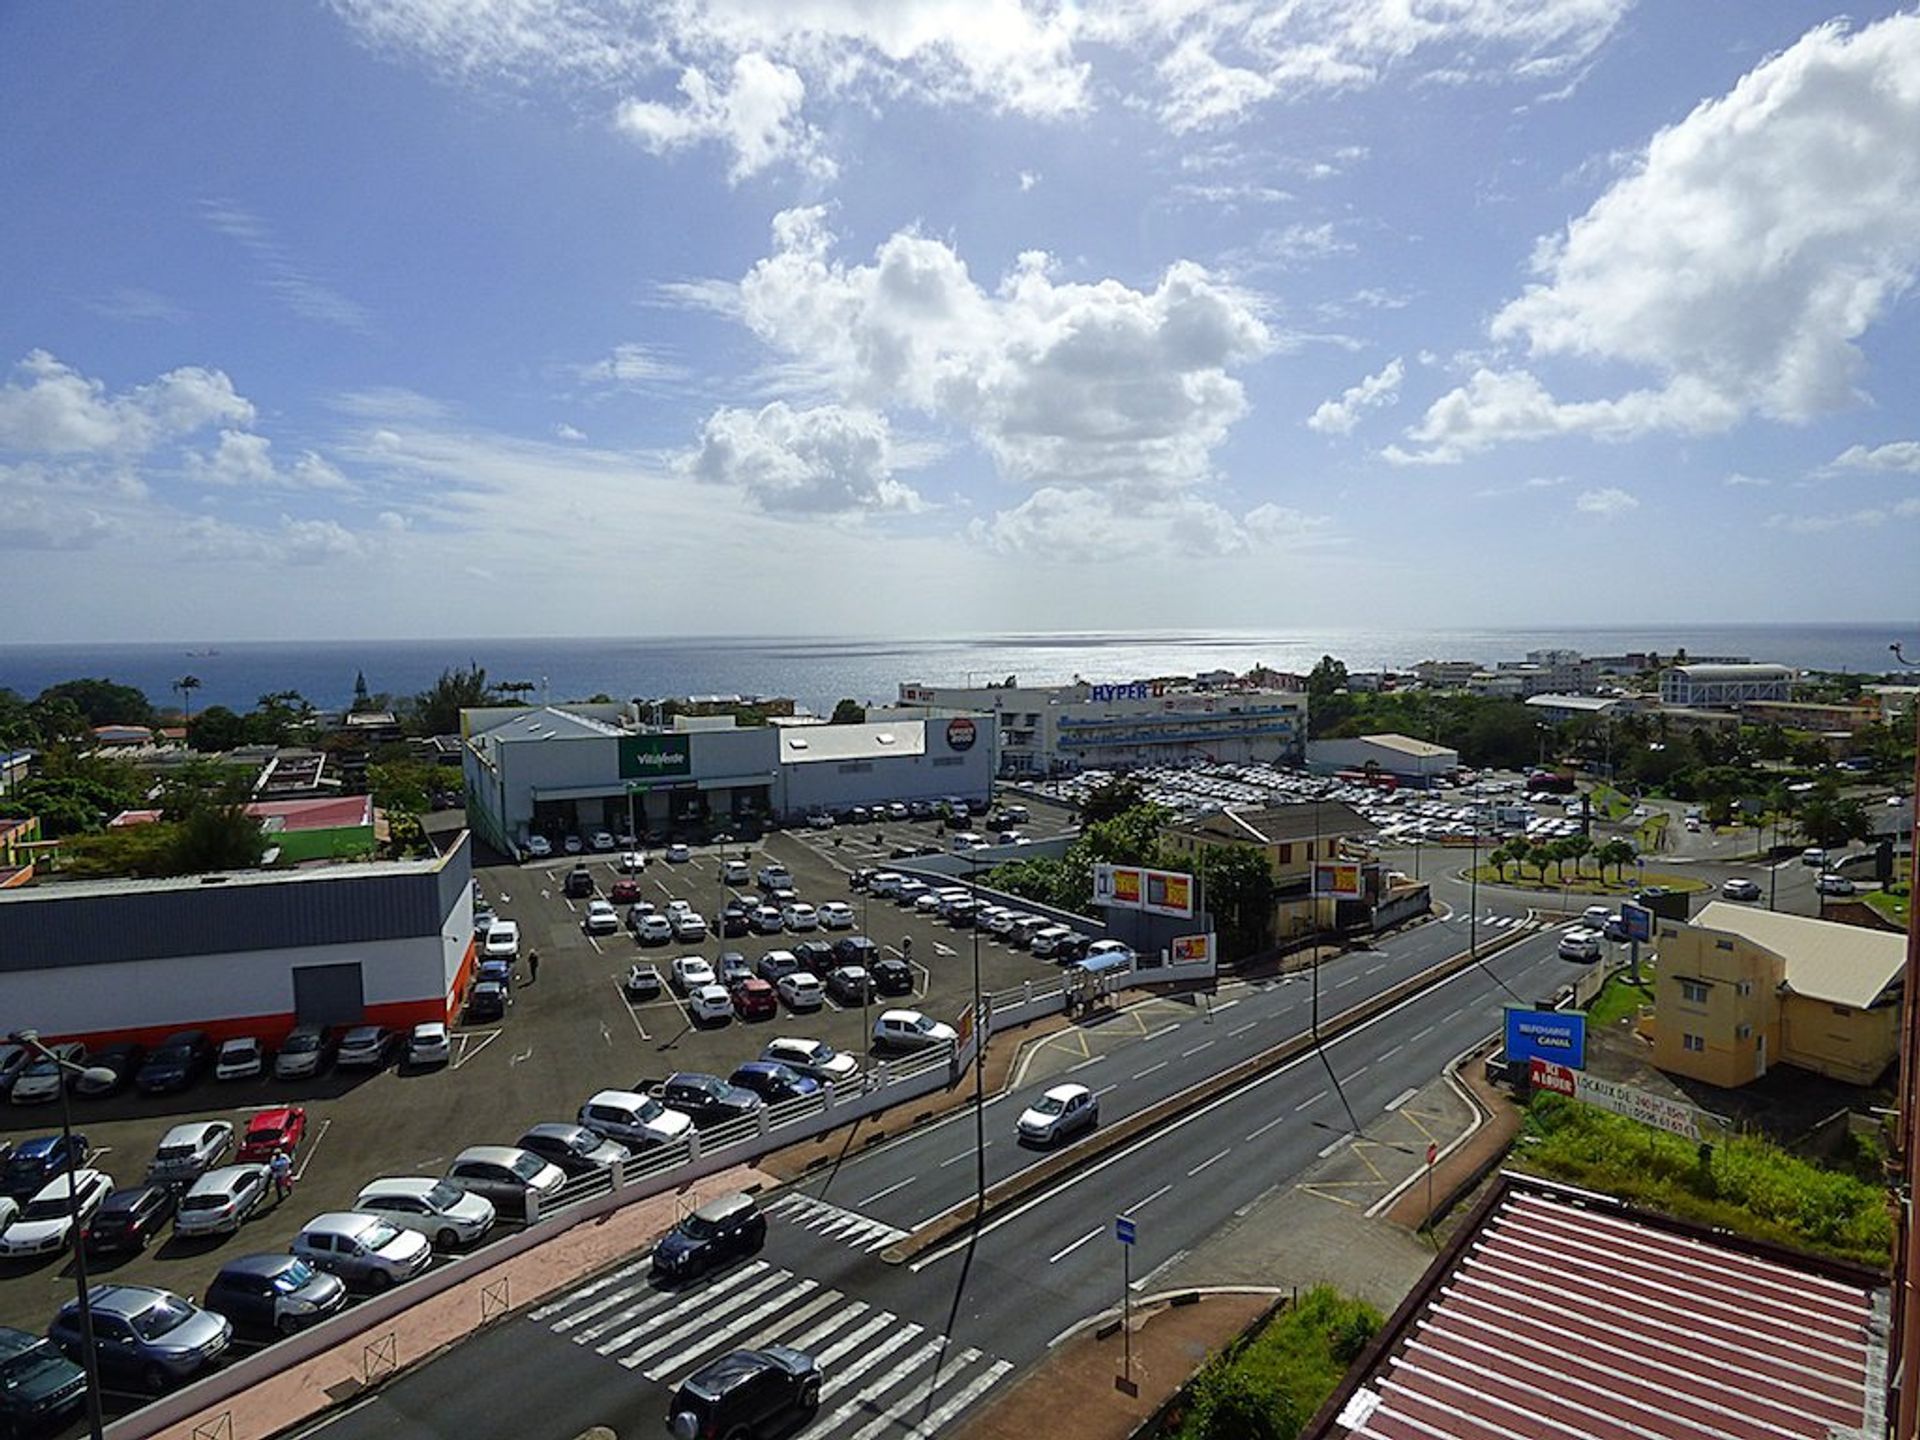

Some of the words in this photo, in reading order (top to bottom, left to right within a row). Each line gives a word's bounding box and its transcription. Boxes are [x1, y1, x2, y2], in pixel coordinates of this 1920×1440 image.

[1093, 684, 1147, 701] HYPER
[1152, 684, 1164, 698] U
[1537, 1036, 1571, 1049] CANAL
[1541, 1073, 1573, 1093] LOUER
[1577, 1075, 1615, 1099] LOCAUX
[1618, 1088, 1633, 1102] DE
